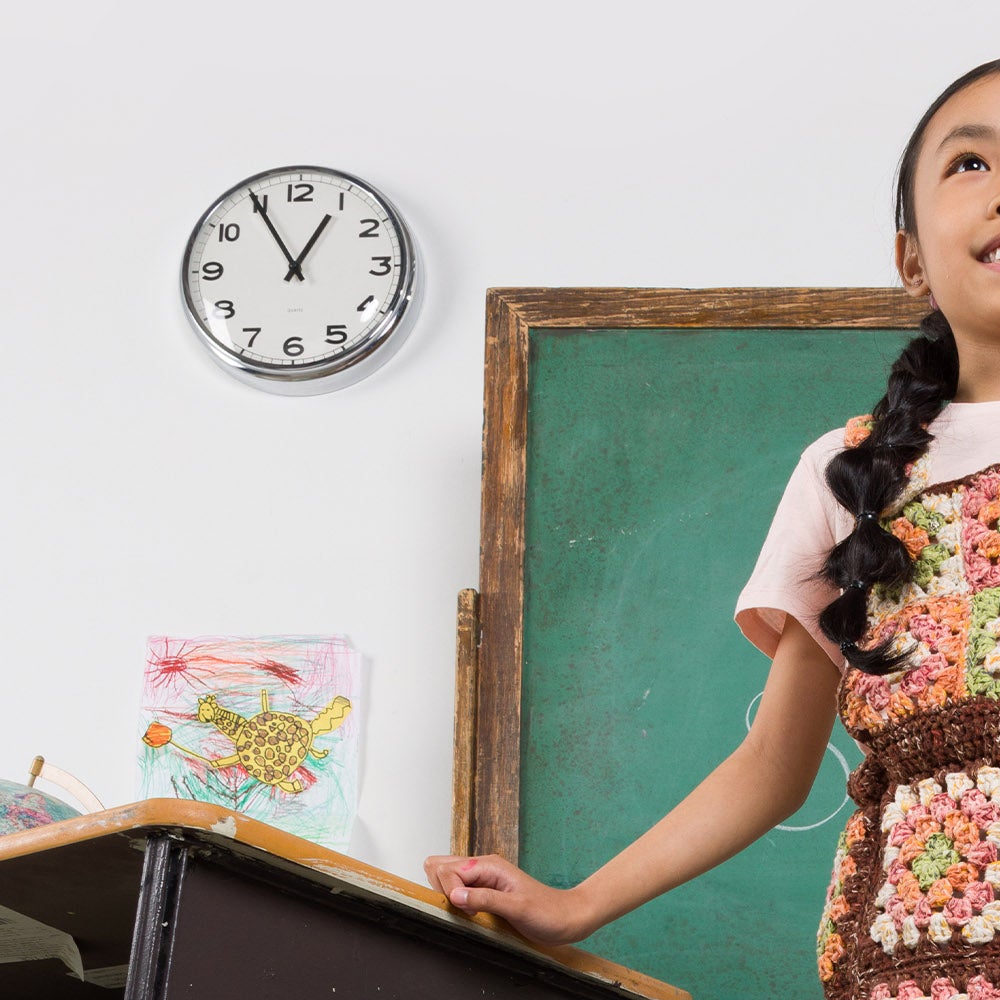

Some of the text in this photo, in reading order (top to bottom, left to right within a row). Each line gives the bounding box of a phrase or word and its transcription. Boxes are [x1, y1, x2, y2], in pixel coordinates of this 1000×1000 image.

[287, 183, 314, 202] 12
[339, 192, 345, 211] 1
[253, 194, 268, 213] 11
[218, 223, 241, 242] 10
[358, 218, 380, 238] 2
[202, 261, 224, 281] 9
[368, 256, 392, 276] 3
[213, 300, 236, 320] 8
[242, 327, 262, 348] 7
[324, 324, 348, 345] 5
[282, 336, 304, 357] 6
